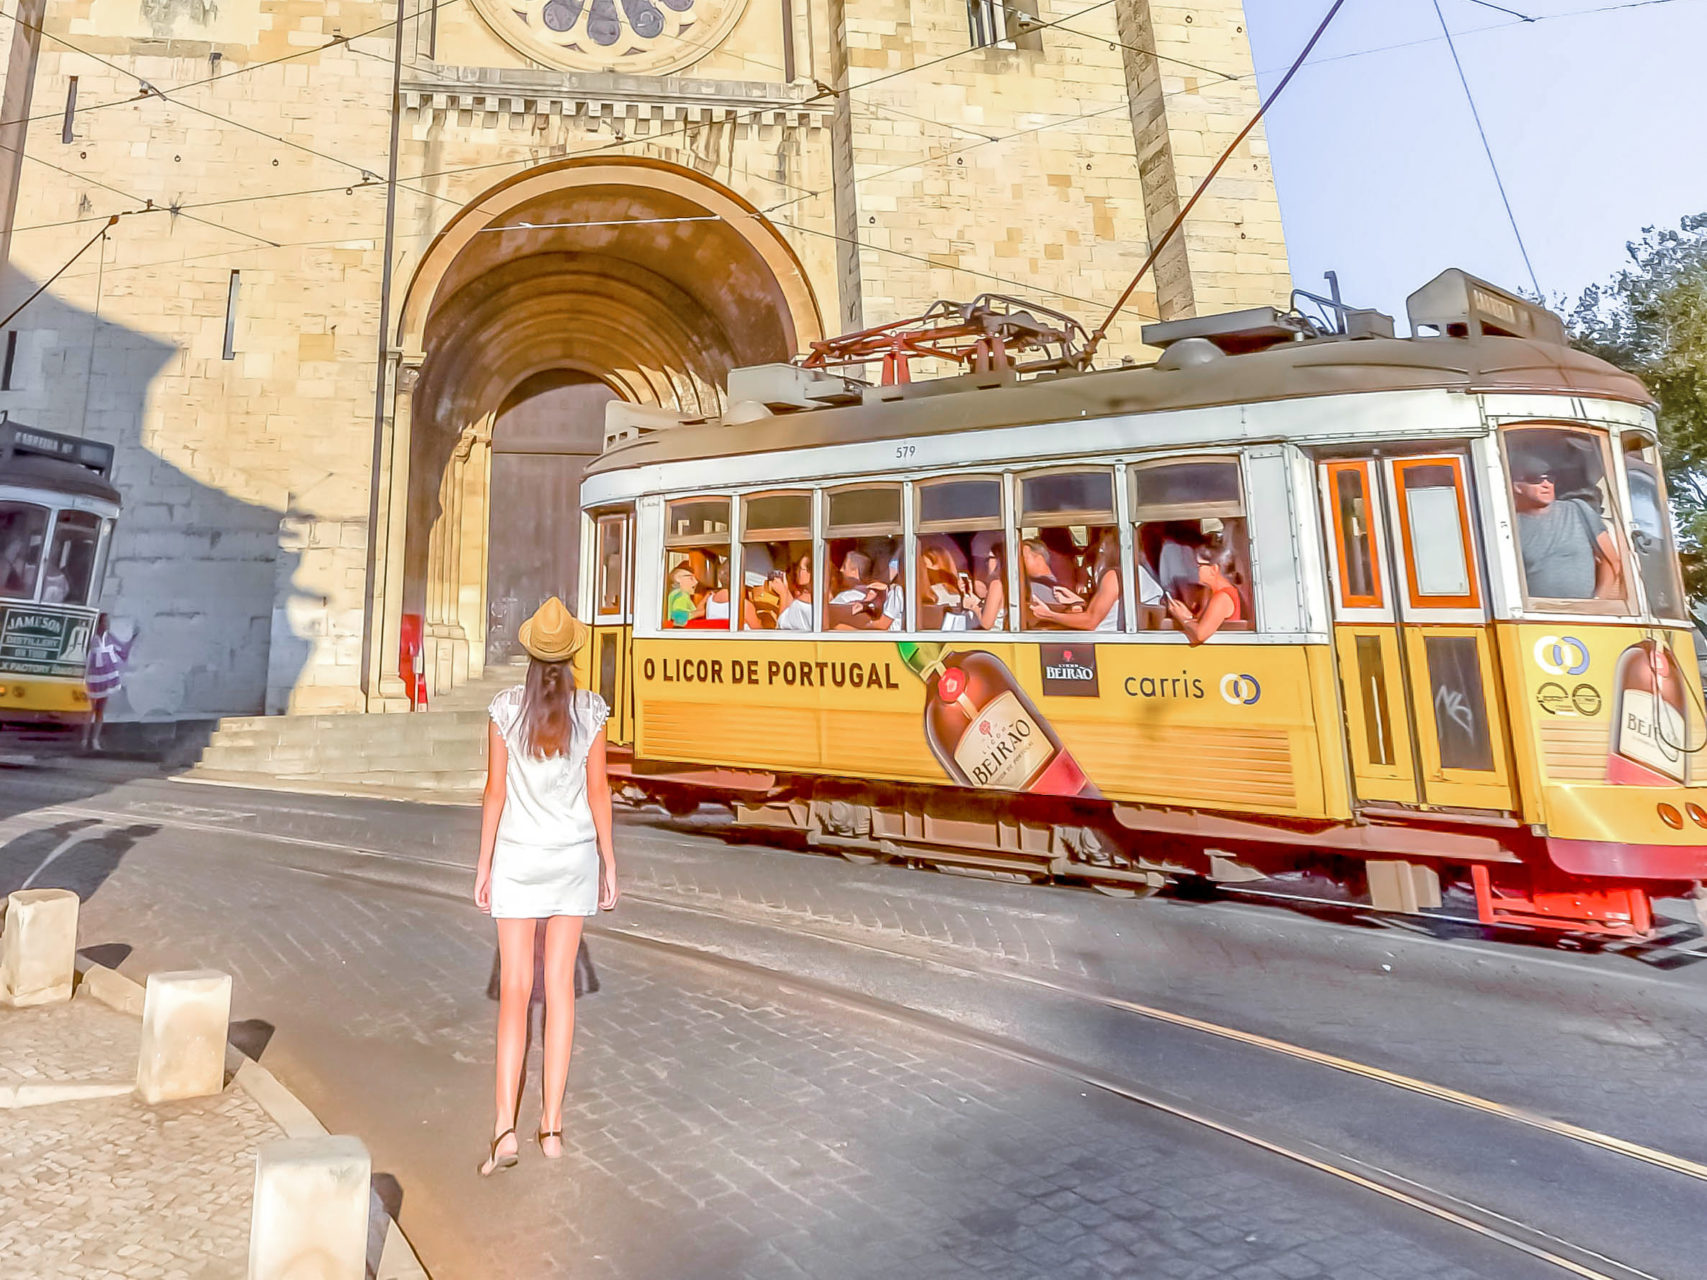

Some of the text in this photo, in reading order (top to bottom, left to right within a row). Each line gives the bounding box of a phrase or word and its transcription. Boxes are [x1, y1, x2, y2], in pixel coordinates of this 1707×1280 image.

[896, 445, 916, 459] 579
[643, 658, 899, 689] O LICOR DE PORTUGAL
[1046, 666, 1094, 680] BEIRÃO
[1124, 670, 1204, 699] carris
[972, 719, 1031, 786] BEIRÃO
